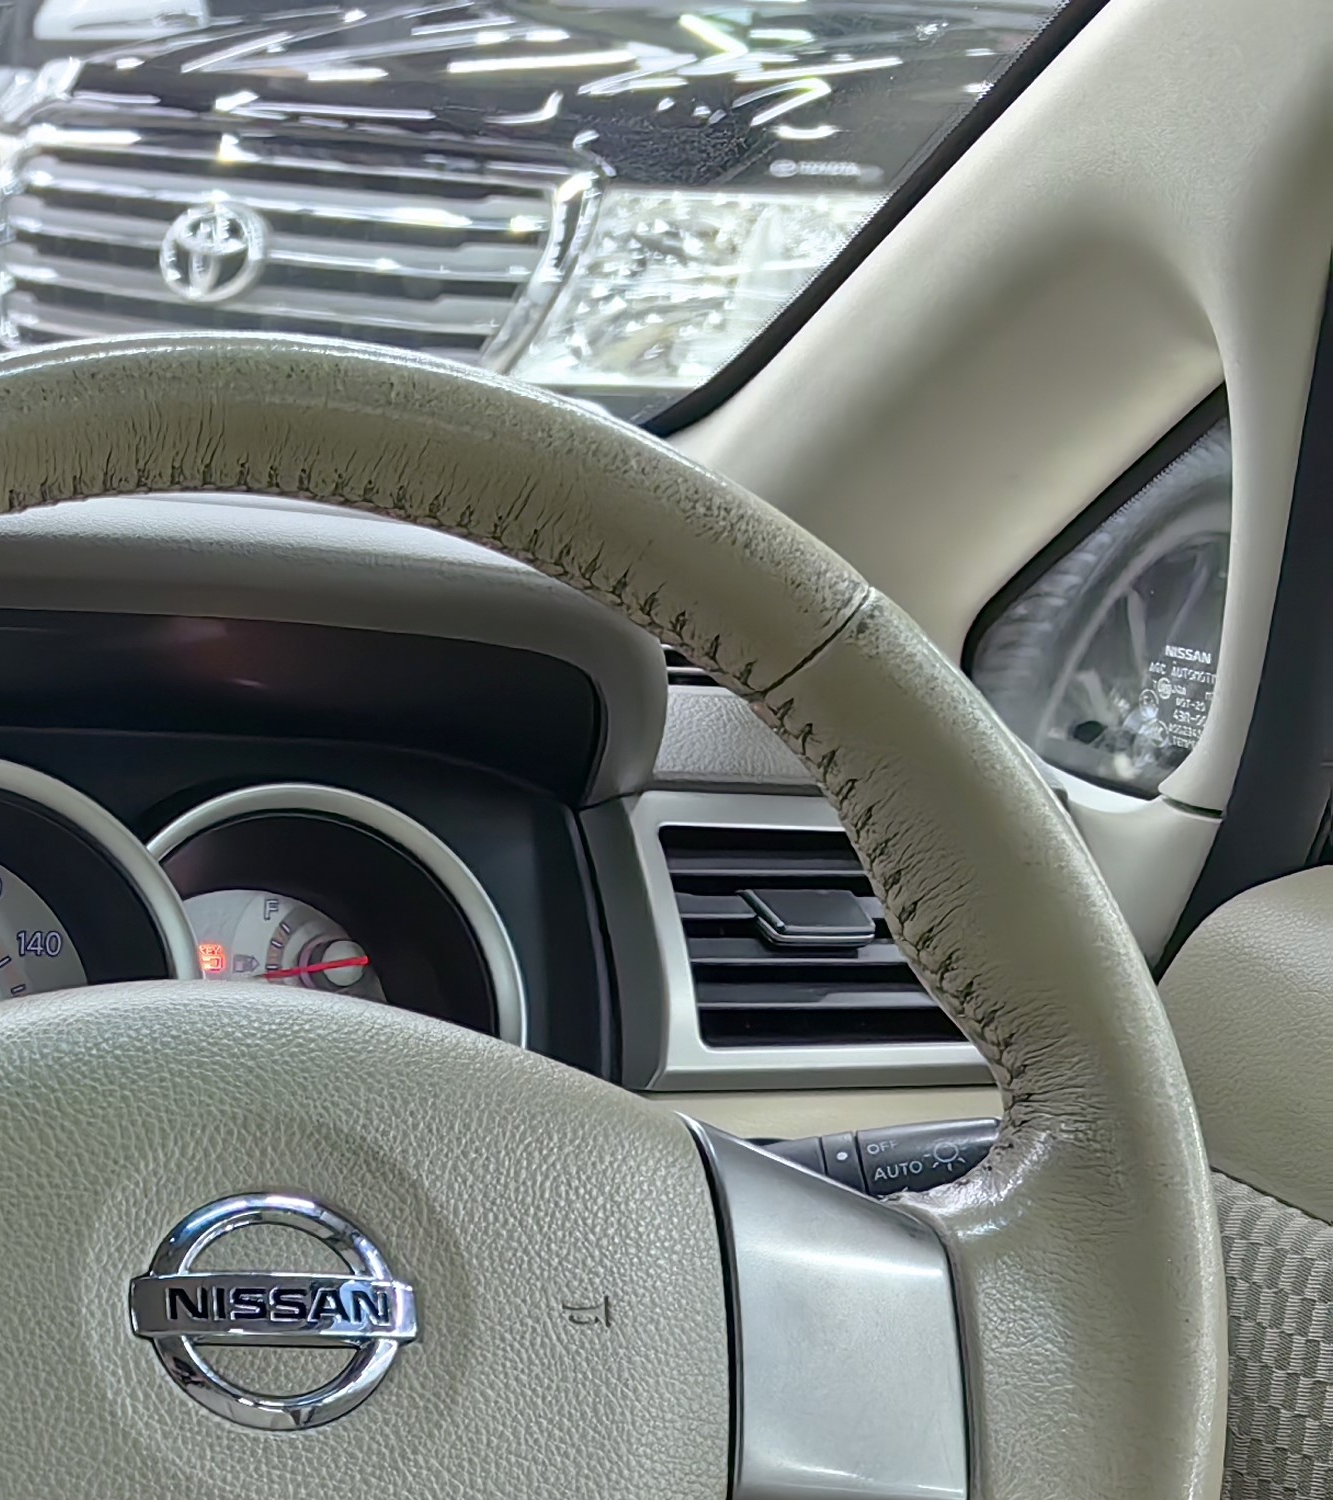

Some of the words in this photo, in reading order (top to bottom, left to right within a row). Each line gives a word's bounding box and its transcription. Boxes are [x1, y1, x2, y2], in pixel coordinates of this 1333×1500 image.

[1165, 644, 1212, 665] NISSAN
[263, 898, 280, 921] F
[16, 930, 63, 957] 140
[866, 1139, 898, 1155] OFF
[874, 1160, 924, 1182] AUTO
[165, 1285, 392, 1327] NISSAN
